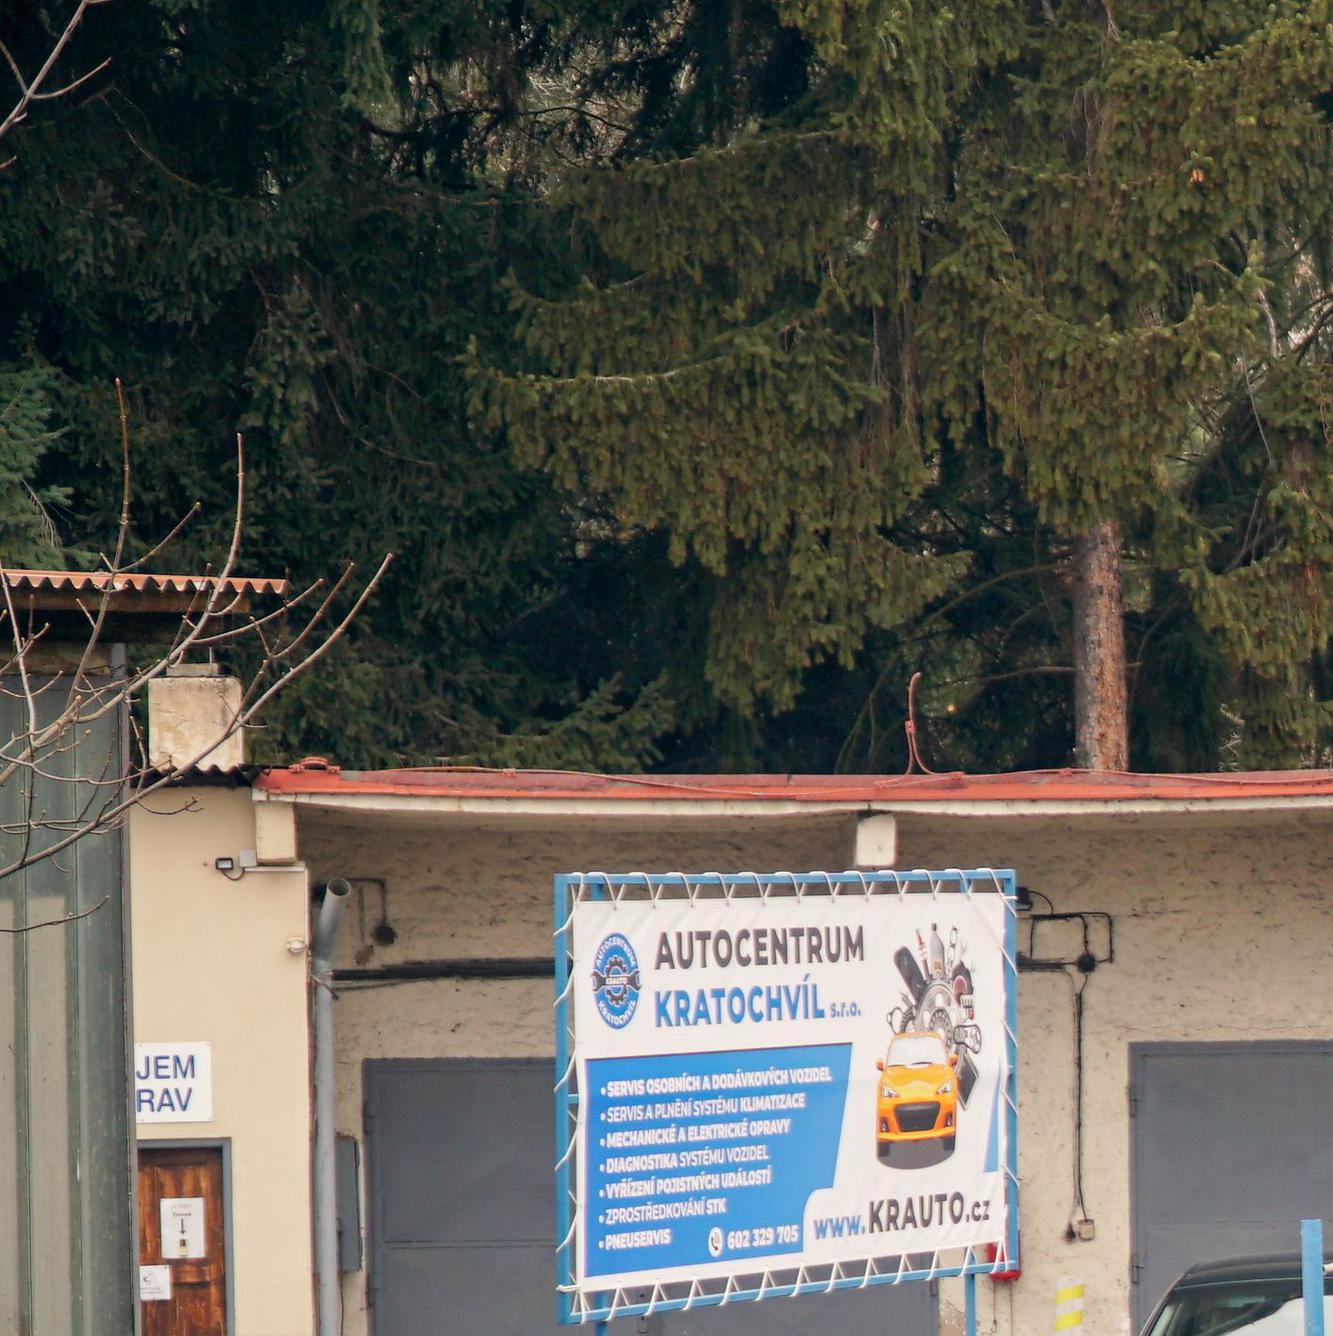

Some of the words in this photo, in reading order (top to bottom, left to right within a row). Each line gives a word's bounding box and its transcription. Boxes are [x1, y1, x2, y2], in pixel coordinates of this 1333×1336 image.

[654, 926, 864, 969] AUTOCENTRUM
[655, 973, 825, 1027] KRATOCHVÍL
[136, 1054, 195, 1079] JEM
[607, 1080, 644, 1097] SERVIS
[646, 1072, 700, 1094] OSOBNÍCH
[702, 1074, 711, 1089] A
[712, 1066, 788, 1089] DODÁVKOVÝCH
[790, 1066, 832, 1083] VOZIDEL
[136, 1087, 192, 1112] RAV
[607, 1106, 644, 1122] SERVIS
[646, 1105, 653, 1119] A
[655, 1097, 692, 1118] PLNĚNÍ
[693, 1095, 738, 1115] SYSTÉMU
[739, 1093, 805, 1113] KLIMATIZACE
[606, 1123, 676, 1148] MECHANICKÉ
[677, 1127, 686, 1142] A
[687, 1117, 748, 1141] ELEKTRICKÉ
[749, 1118, 791, 1135] OPRAVY
[606, 1153, 678, 1173] DIAGNOSTIKA
[679, 1146, 725, 1167] SYSTÉMU
[726, 1144, 769, 1162] VOZIDEL
[656, 1171, 720, 1194] POJISTNÝCH
[605, 1196, 705, 1225] ZPROSTŘEDKOVÁNÍ
[706, 1198, 726, 1213] STK
[813, 1191, 991, 1240] www.KRAUTO.cz
[605, 1228, 671, 1249] PNEUSERVIS
[727, 1231, 750, 1250] 602
[752, 1228, 774, 1247] 329
[777, 1225, 799, 1243] 705
